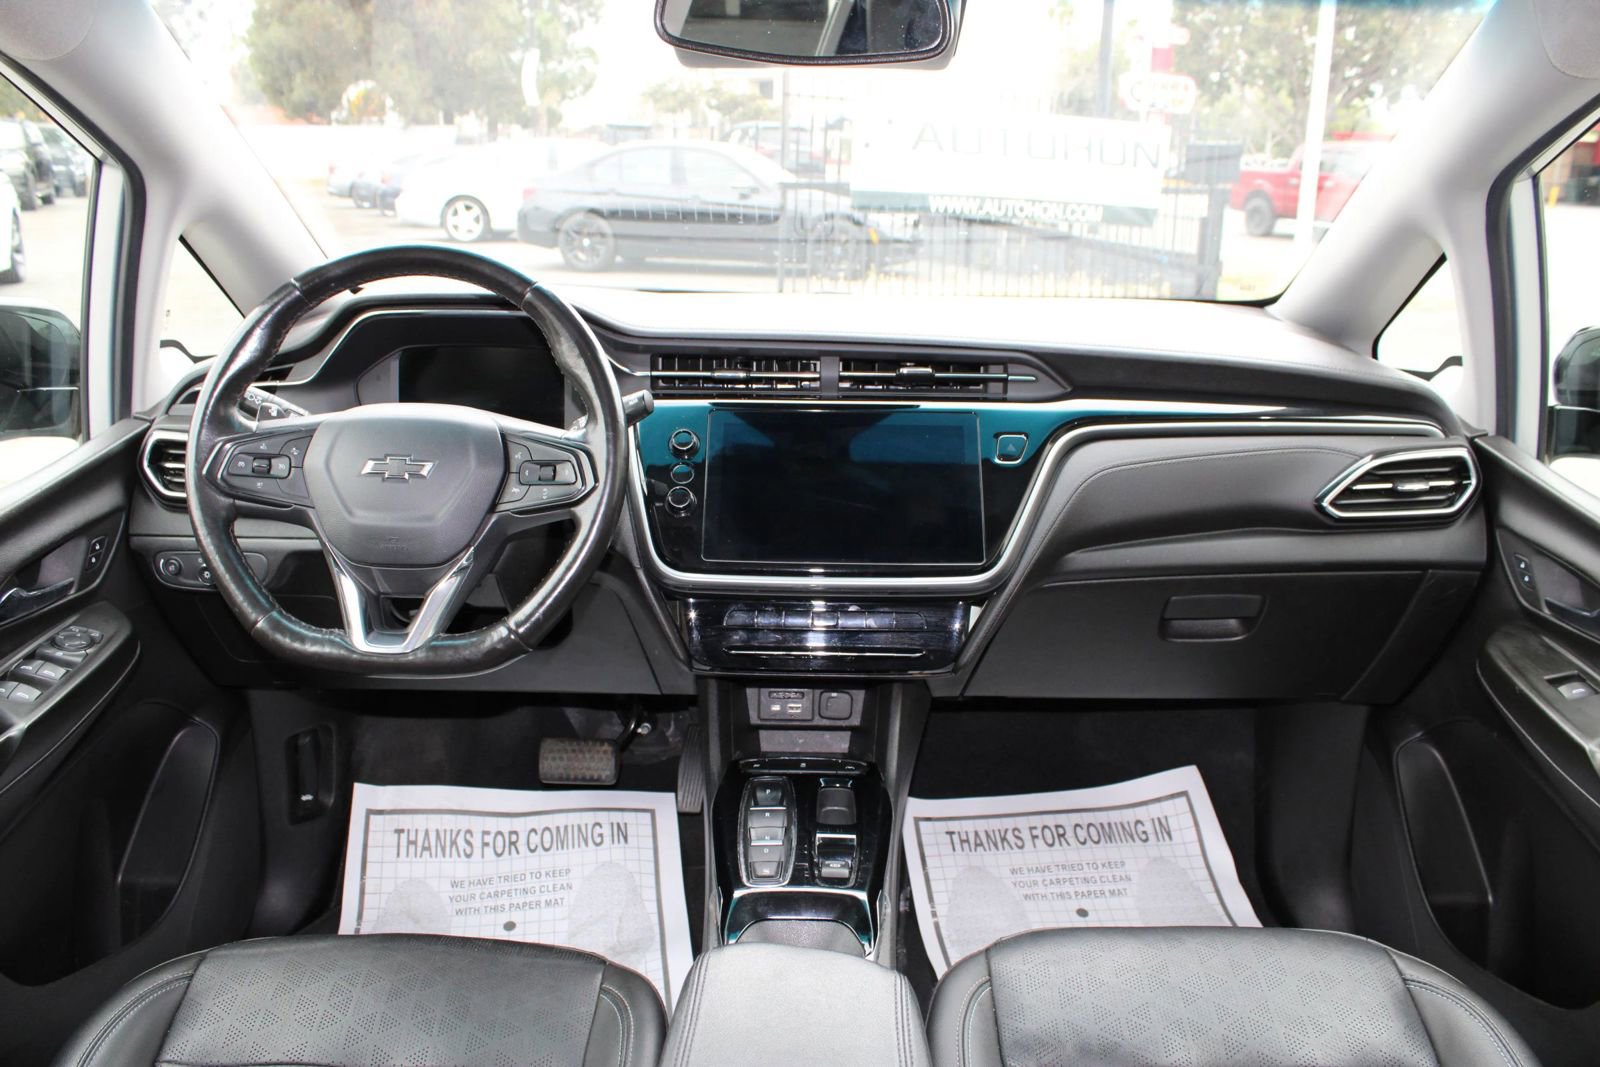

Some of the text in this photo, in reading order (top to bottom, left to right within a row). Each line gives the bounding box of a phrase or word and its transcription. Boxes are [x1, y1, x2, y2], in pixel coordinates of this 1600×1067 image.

[394, 822, 628, 858] THANKS FOR COMING IN
[946, 816, 1173, 852] THANKS FOR COMING IN
[1009, 861, 1126, 875] WE HAVE TRIED TO KEEP
[450, 869, 571, 889] WE HAVE TRIED TO KEEP
[1012, 874, 1132, 889] YOUR CARPETING CLEAN
[449, 883, 573, 903] YOUR CARPETING CLEAN
[1023, 888, 1128, 901] WITH THIS PAPER MAT
[455, 897, 565, 916] WITH THIS PAPER MAT
